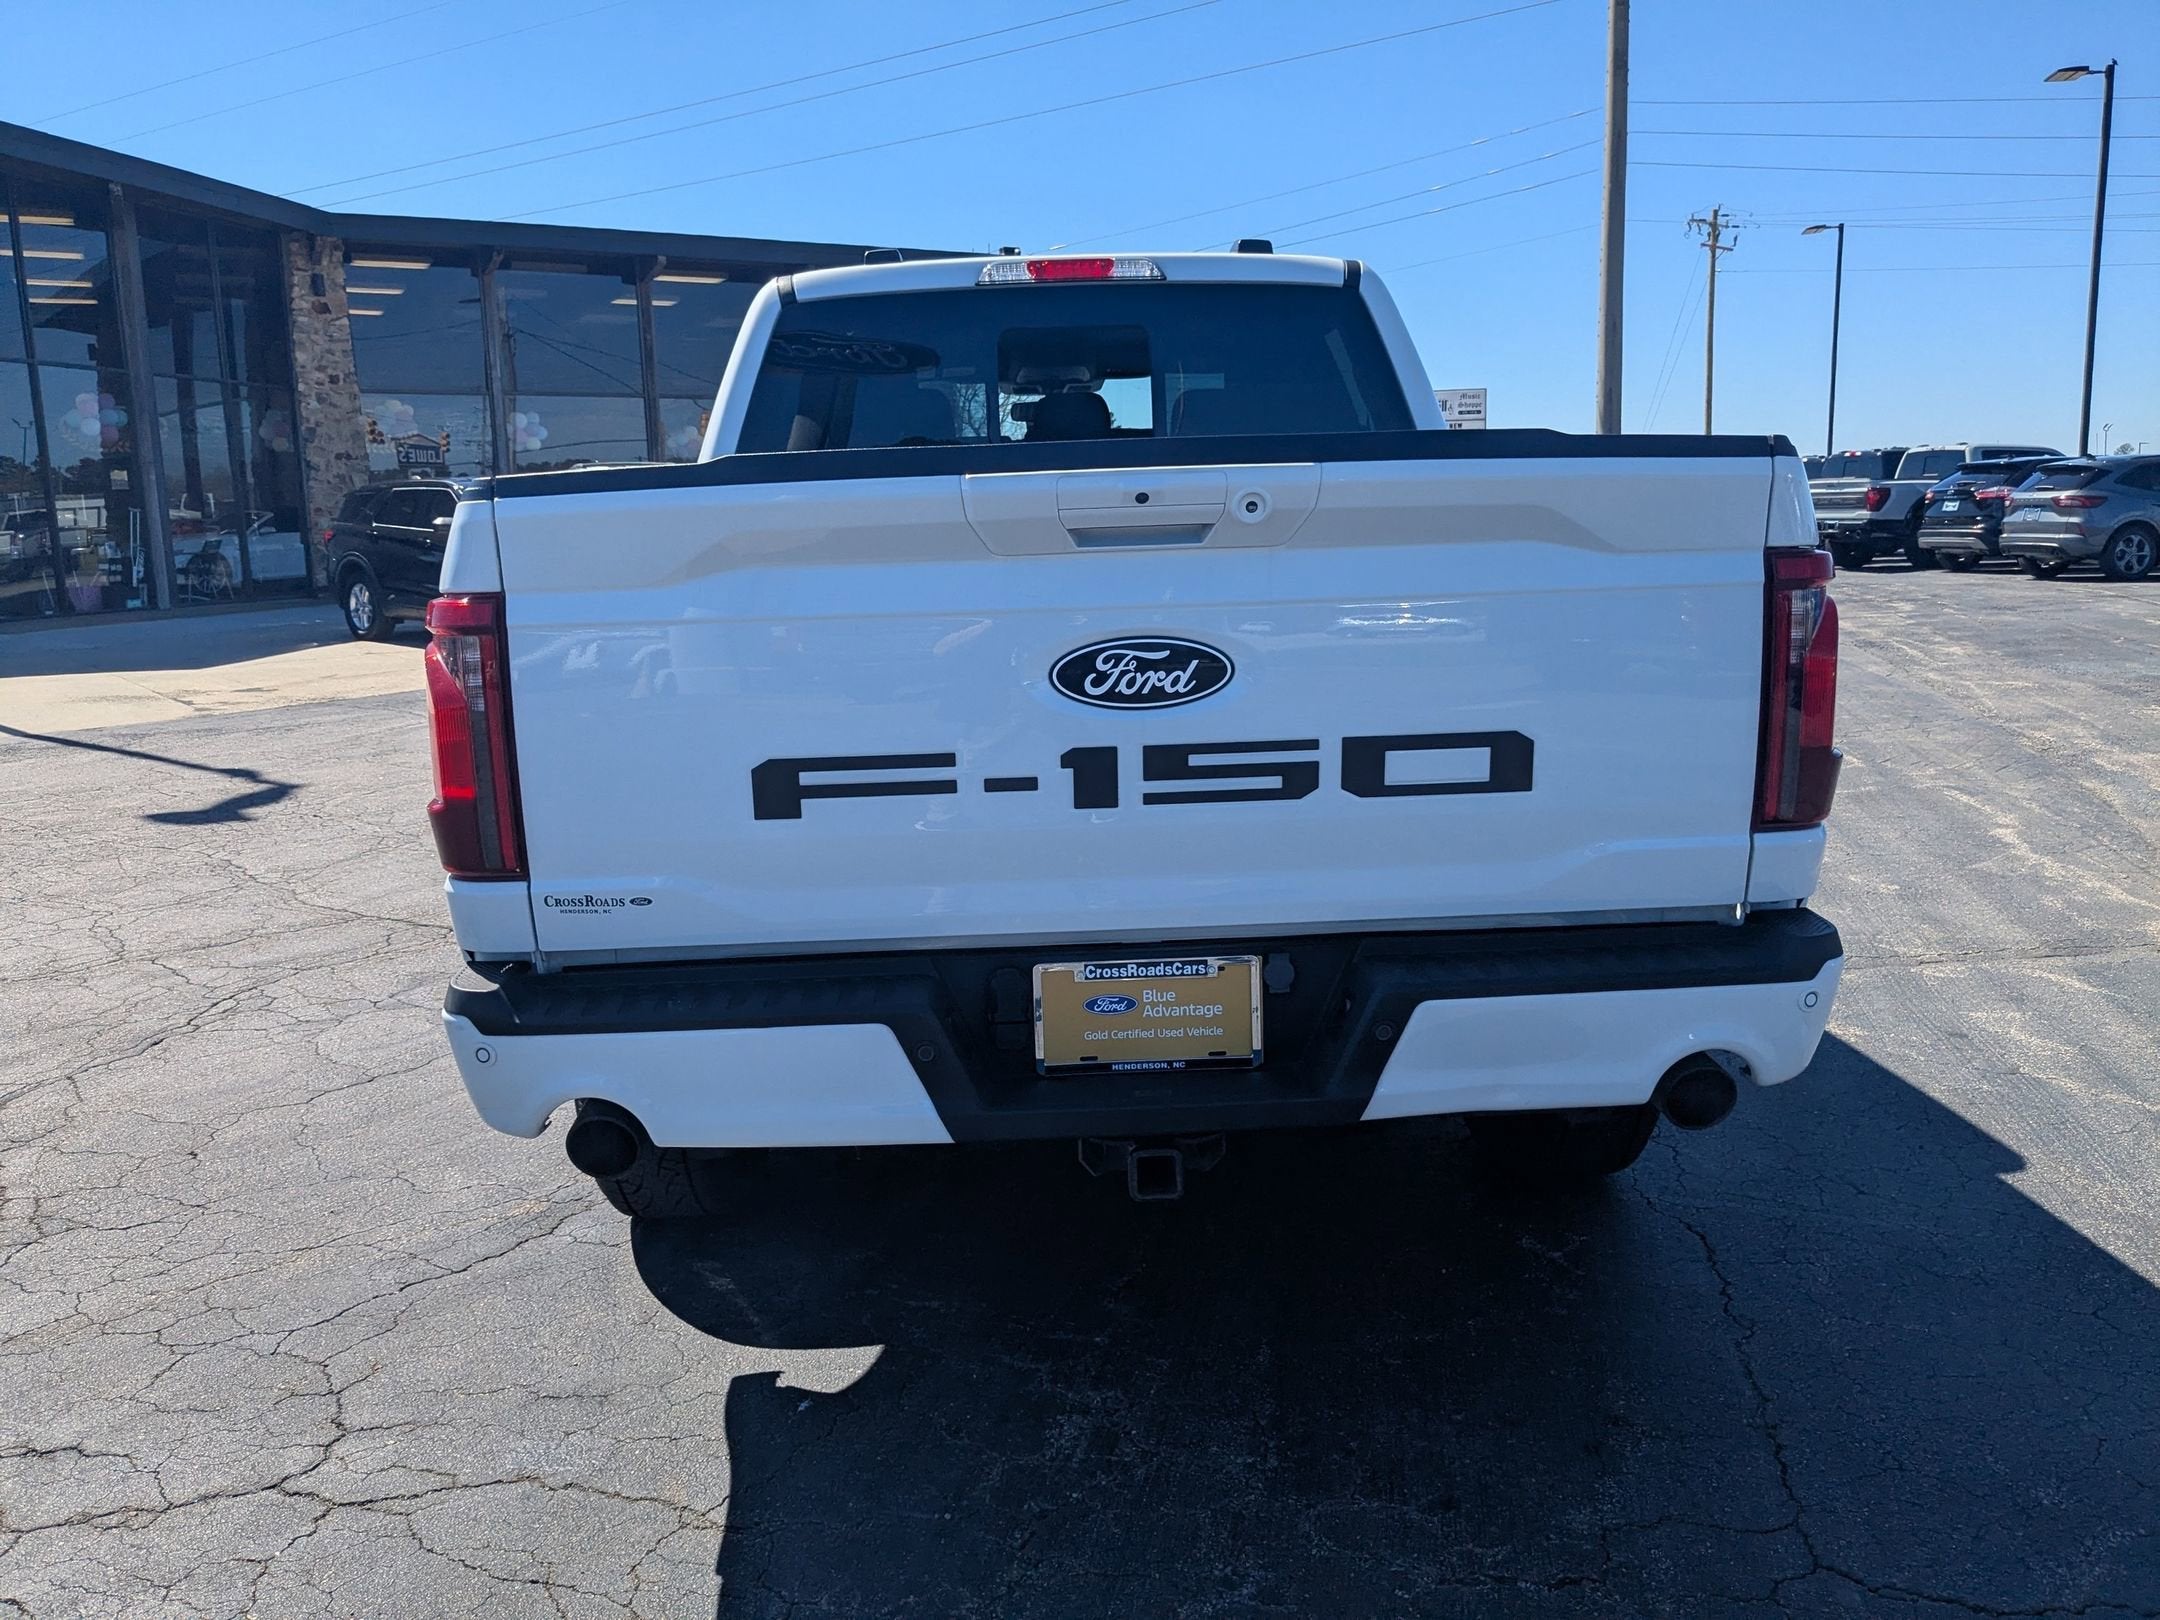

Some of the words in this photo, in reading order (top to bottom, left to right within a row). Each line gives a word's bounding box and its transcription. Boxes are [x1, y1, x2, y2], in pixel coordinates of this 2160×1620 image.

[1083, 649, 1200, 696] Ford
[751, 730, 1535, 820] F-150
[1085, 962, 1206, 979] CrossRoadsCars
[1142, 989, 1176, 1003] Blue
[1093, 997, 1128, 1012] Ford
[1142, 1002, 1223, 1018] Advantage
[1084, 1030, 1109, 1041] Gold
[1111, 1028, 1155, 1039] Certified
[1157, 1027, 1184, 1038] Used
[1186, 1026, 1224, 1037] Vehicle
[1112, 1062, 1171, 1071] HENDERSON,
[1172, 1061, 1186, 1069] NC
